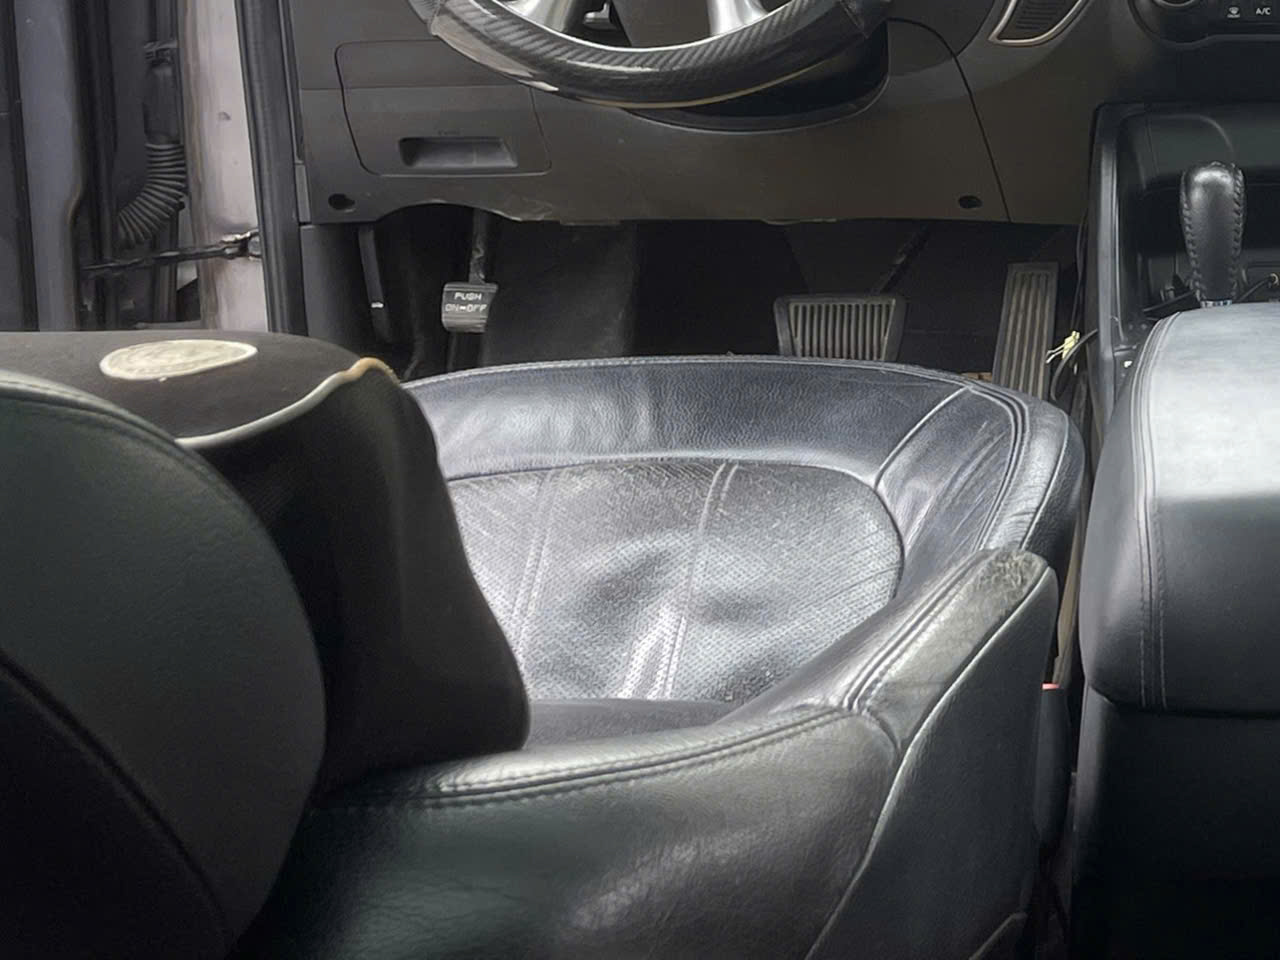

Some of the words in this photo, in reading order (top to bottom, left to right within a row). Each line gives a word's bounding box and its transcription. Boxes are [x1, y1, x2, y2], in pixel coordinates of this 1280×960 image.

[1255, 7, 1271, 15] A/C
[454, 292, 482, 300] PUSH
[445, 303, 487, 312] ON-OFF
